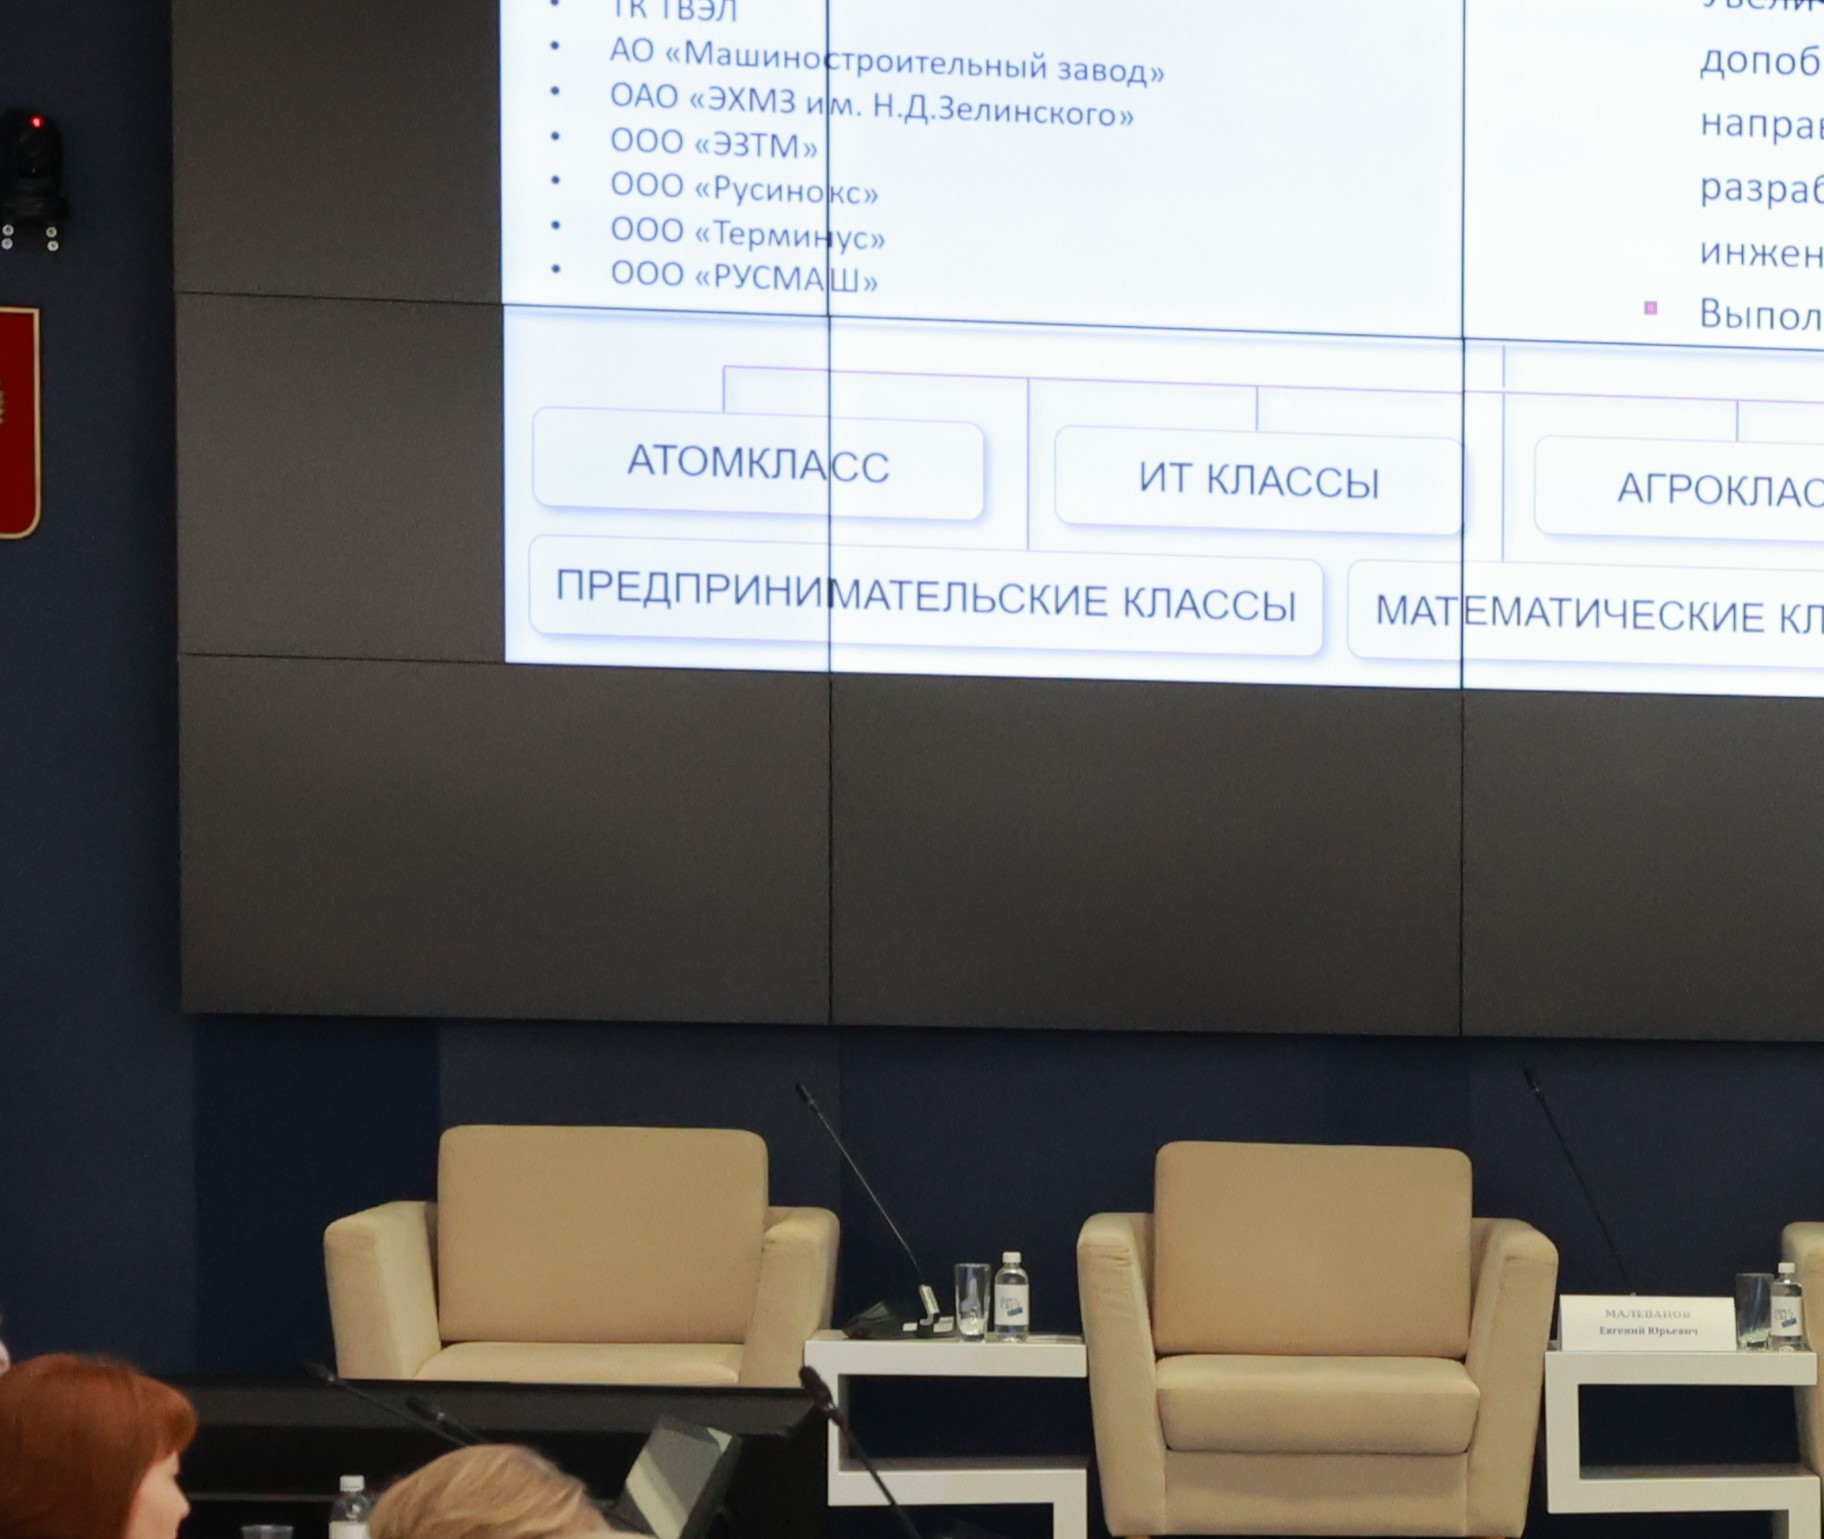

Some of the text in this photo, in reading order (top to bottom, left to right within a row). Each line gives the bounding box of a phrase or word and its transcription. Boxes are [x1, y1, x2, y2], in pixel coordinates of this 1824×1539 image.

[609, 36, 1166, 88] АО «Машиностроительный завод»
[610, 82, 1135, 128] ОАО «ЭХМЗ им. Н.Д.Зелинского»
[610, 126, 819, 160] ООО «ЭЗТМ»
[610, 170, 880, 207] ООО «Русинокс»
[610, 215, 887, 255] ООО «Терминус»
[610, 259, 880, 294] ООО «РУСМАШ»
[626, 442, 891, 484] АТОМКЛАСС
[1139, 460, 1380, 500] ИТ КЛАССЫ
[556, 568, 1297, 624] ПРЕДПРИНИМАТЕЛЬСКИЕ КЛАССЫ
[1376, 593, 1766, 634] МАТЕМАТИЧЕСКИЕ
